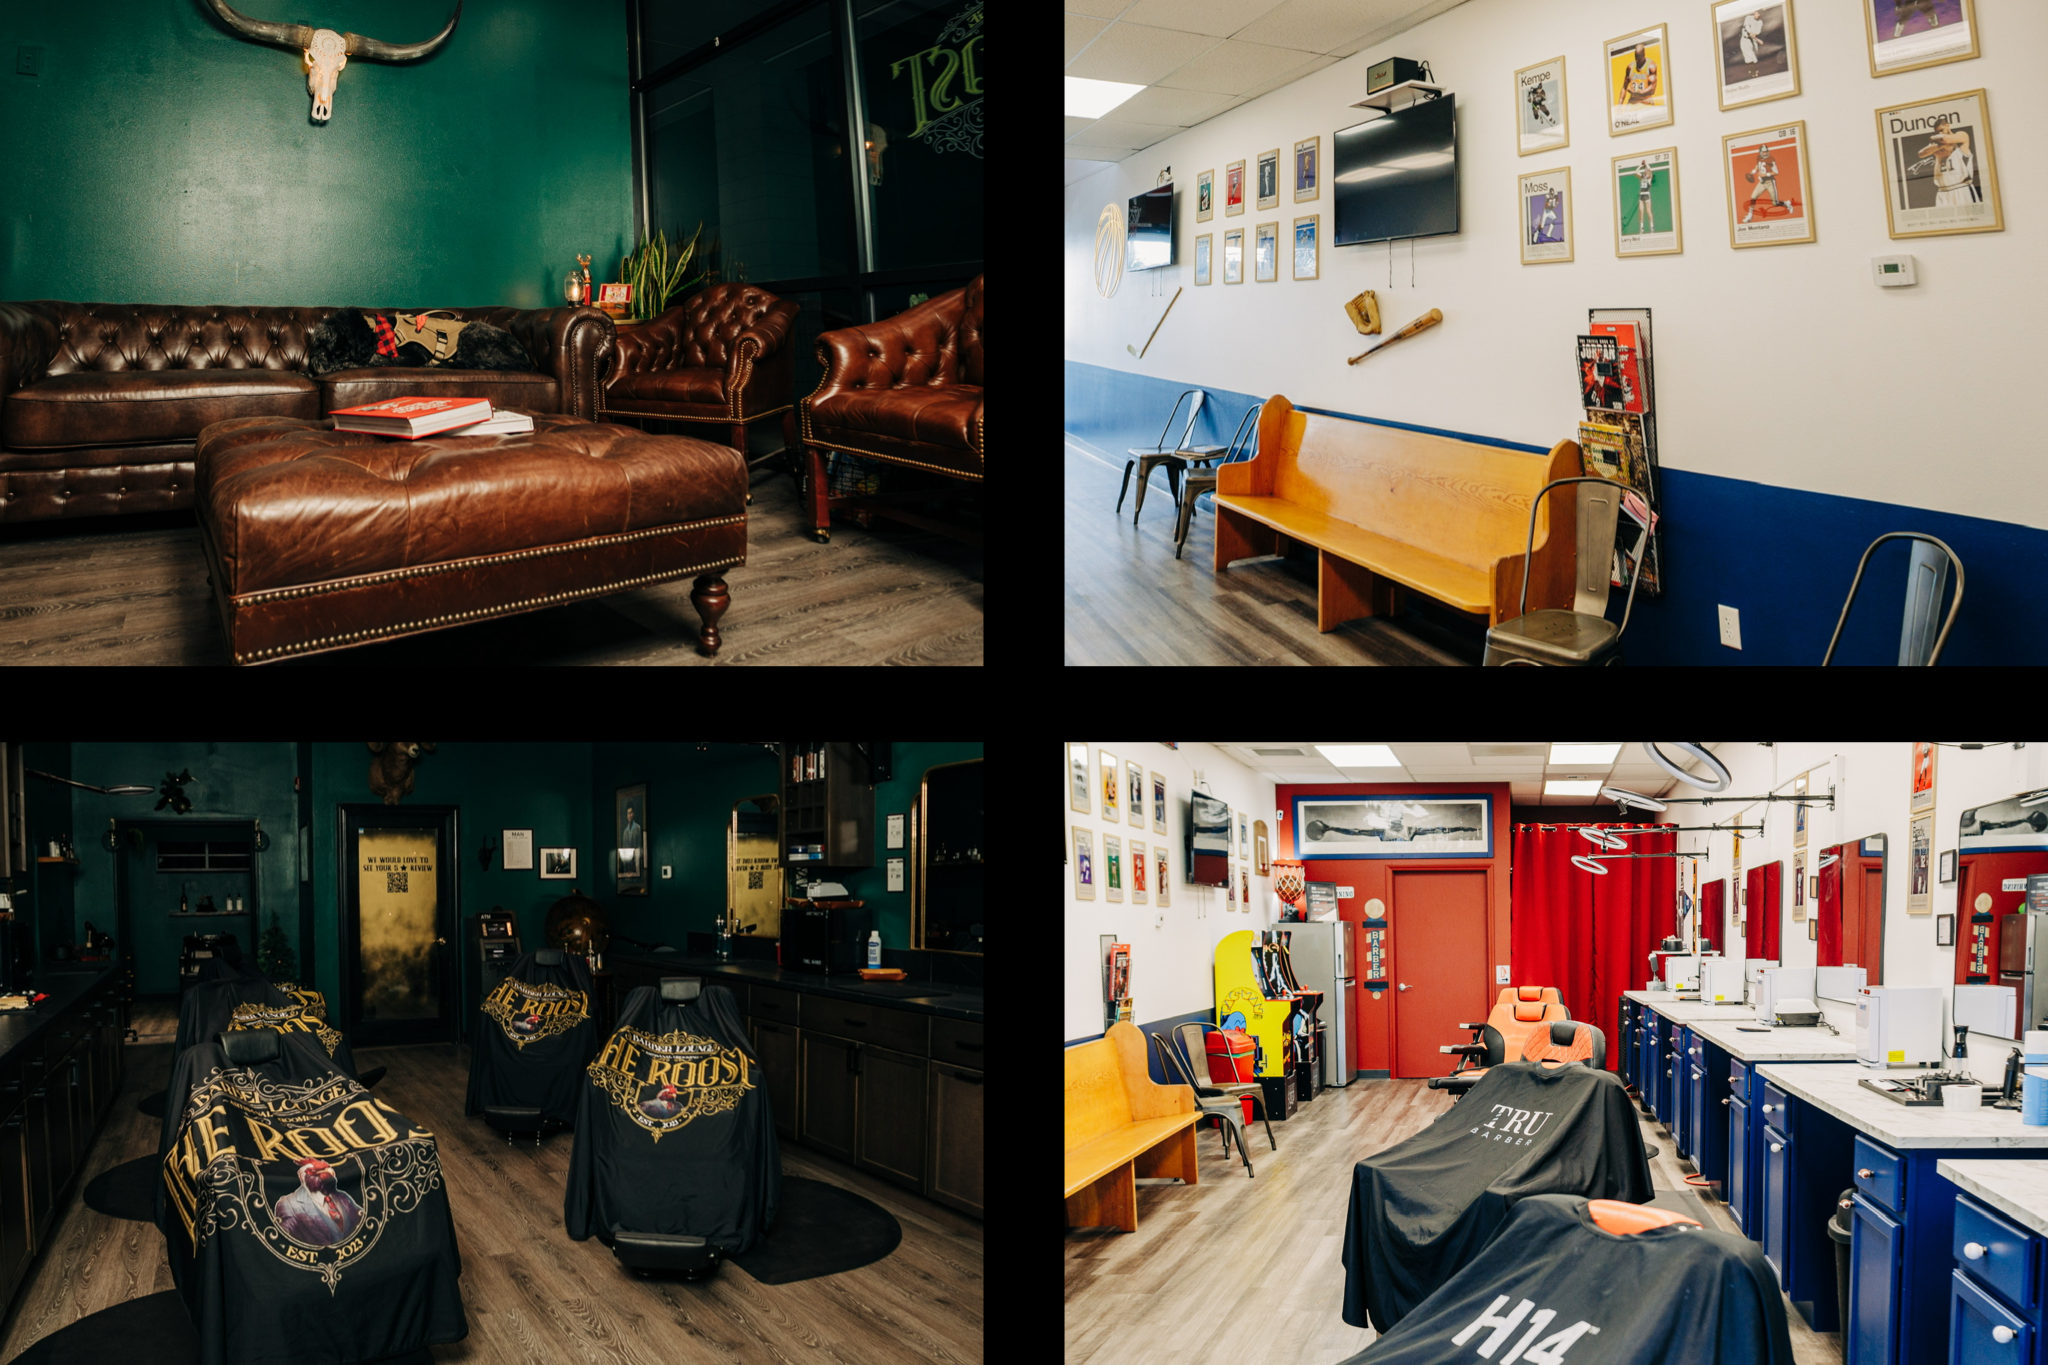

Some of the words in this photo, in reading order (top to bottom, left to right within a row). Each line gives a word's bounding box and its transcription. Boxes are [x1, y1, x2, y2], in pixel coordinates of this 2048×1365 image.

[1521, 71, 1550, 87] Kempe
[1890, 111, 1961, 134] Duncan
[1525, 183, 1548, 194] Moss
[521, 990, 591, 1020] ROOST
[633, 1034, 672, 1052] BARBER
[676, 1044, 714, 1053] LOUNGE
[647, 1047, 756, 1093] ROOST
[267, 1083, 347, 1113] LOUNGE
[1484, 1104, 1553, 1136] TRU
[1470, 1126, 1533, 1146] BARBER
[335, 1239, 364, 1261] 2023
[1451, 1294, 1592, 1365] H14
